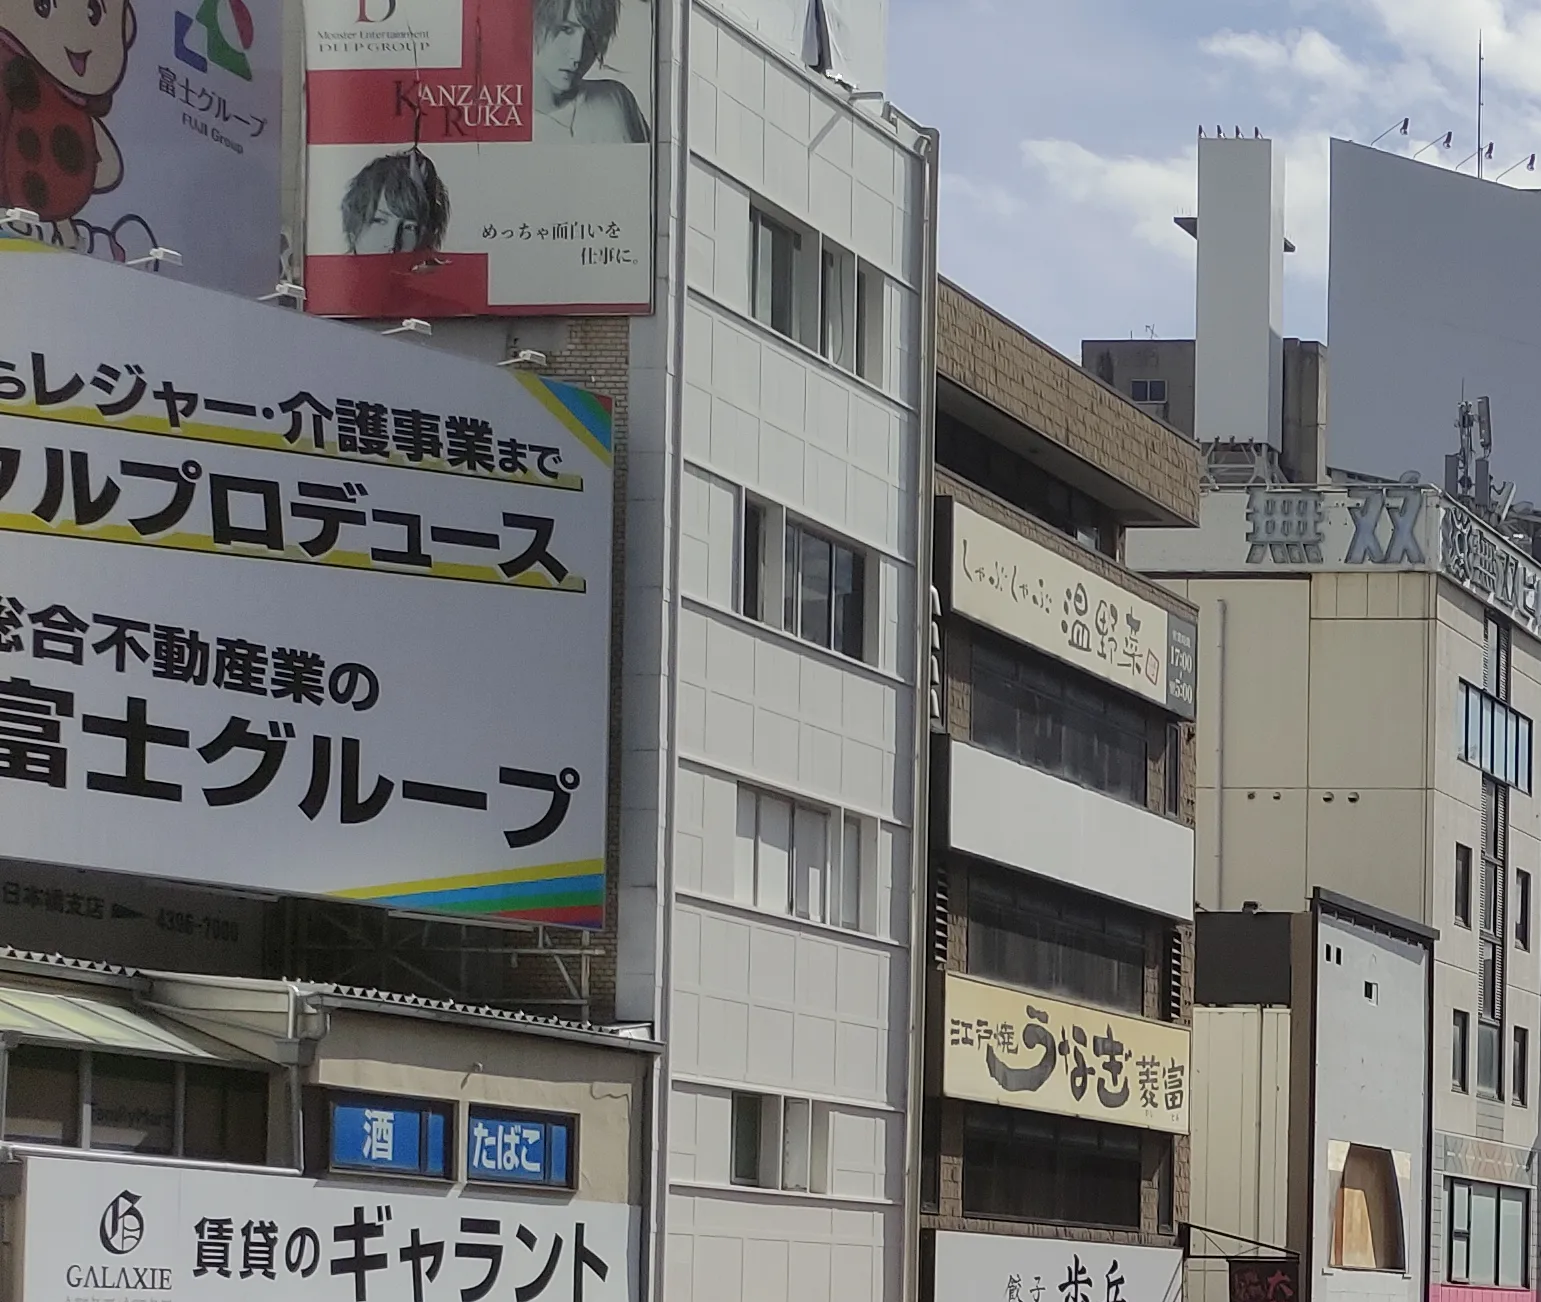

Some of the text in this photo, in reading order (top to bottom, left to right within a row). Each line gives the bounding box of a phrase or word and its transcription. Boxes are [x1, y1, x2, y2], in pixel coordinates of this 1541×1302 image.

[158, 64, 268, 137] 富士グループ
[394, 80, 524, 116] KANZAKI
[182, 112, 209, 137] FUJI
[444, 105, 524, 137] RUKA
[482, 221, 621, 241] めっちゃ面白いを
[581, 247, 639, 265] 仕事に。
[1170, 645, 1193, 674] 17:00
[0, 675, 581, 850] 富士グループ
[950, 1004, 1185, 1111] 江戸焼 うなぎ 菱富
[361, 1109, 395, 1162] 酒
[472, 1121, 542, 1173] たばこ
[66, 1264, 173, 1291] GALAXIE
